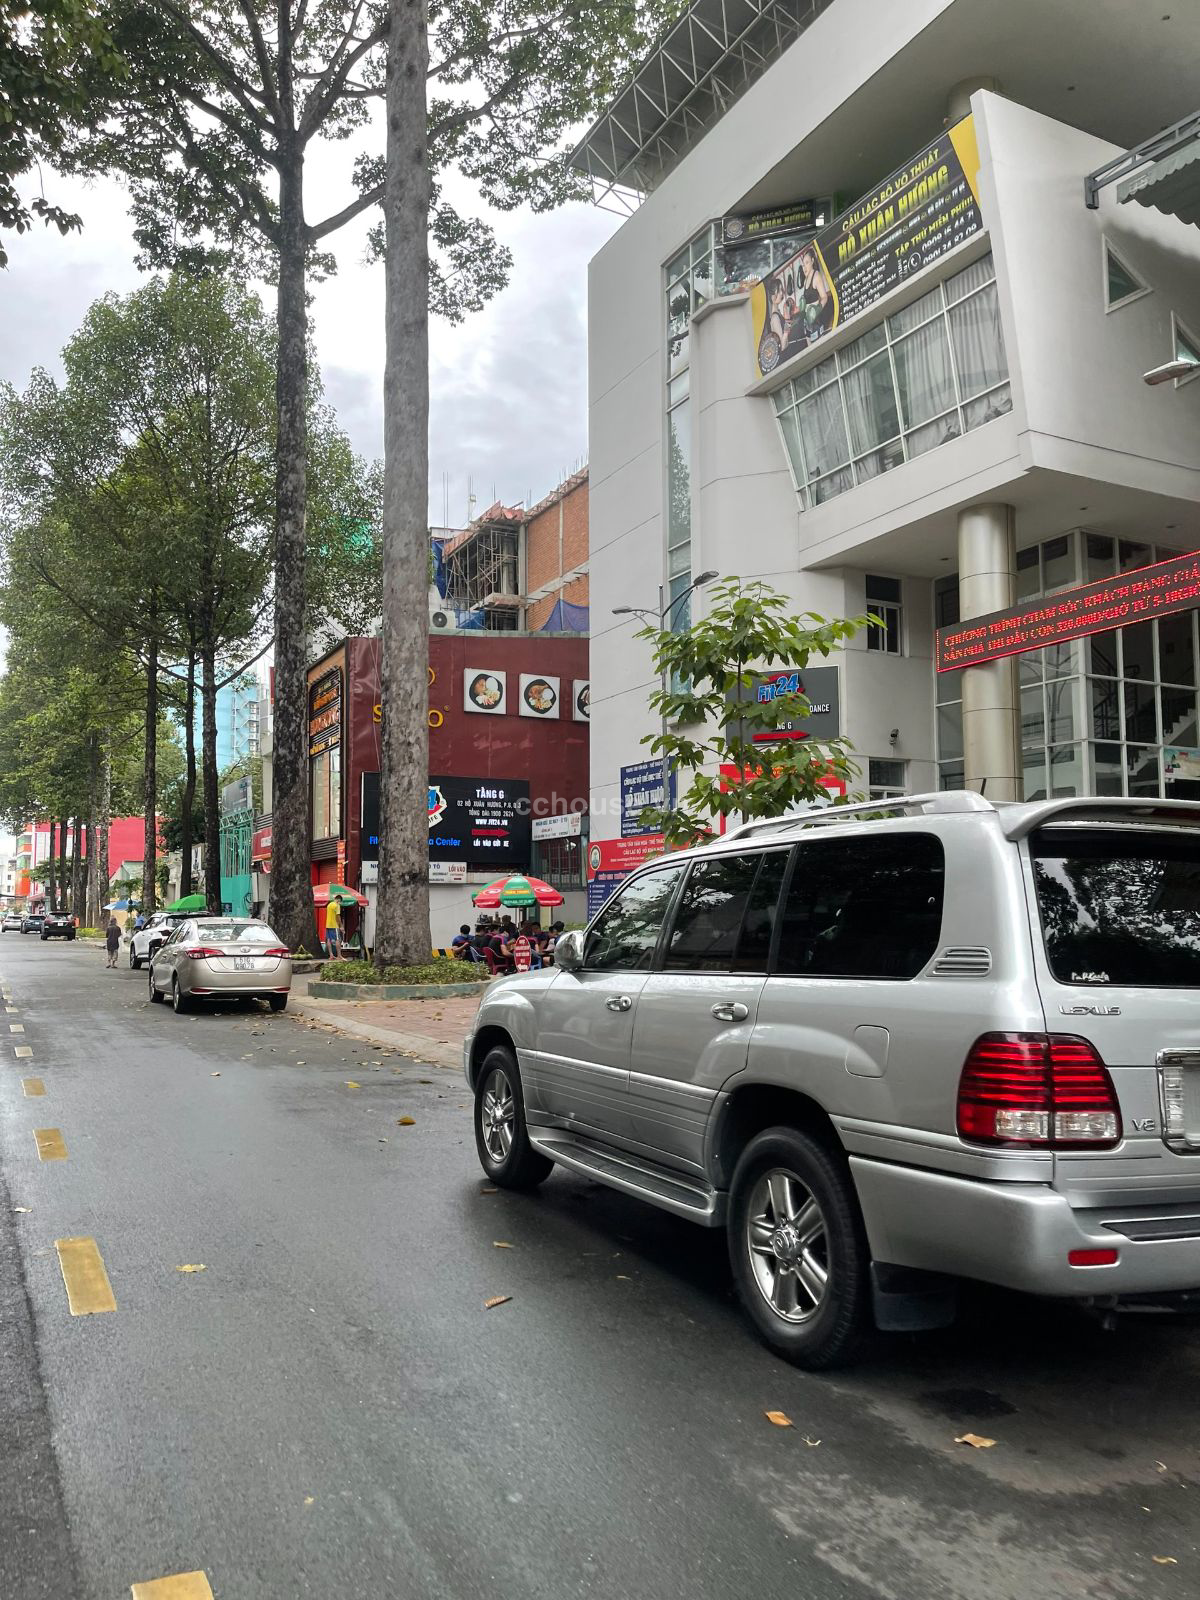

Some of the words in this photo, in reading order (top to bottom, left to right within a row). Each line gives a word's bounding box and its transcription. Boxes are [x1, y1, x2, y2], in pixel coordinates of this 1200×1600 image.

[838, 230, 856, 266] HỒ
[859, 205, 894, 249] XUÂN
[897, 165, 949, 217] HƯƠNG
[809, 703, 830, 713] DANCE
[475, 786, 497, 799] TẦNG
[435, 837, 462, 847] Center
[1058, 1004, 1122, 1016] LEXUS
[1131, 1118, 1156, 1132] V8
